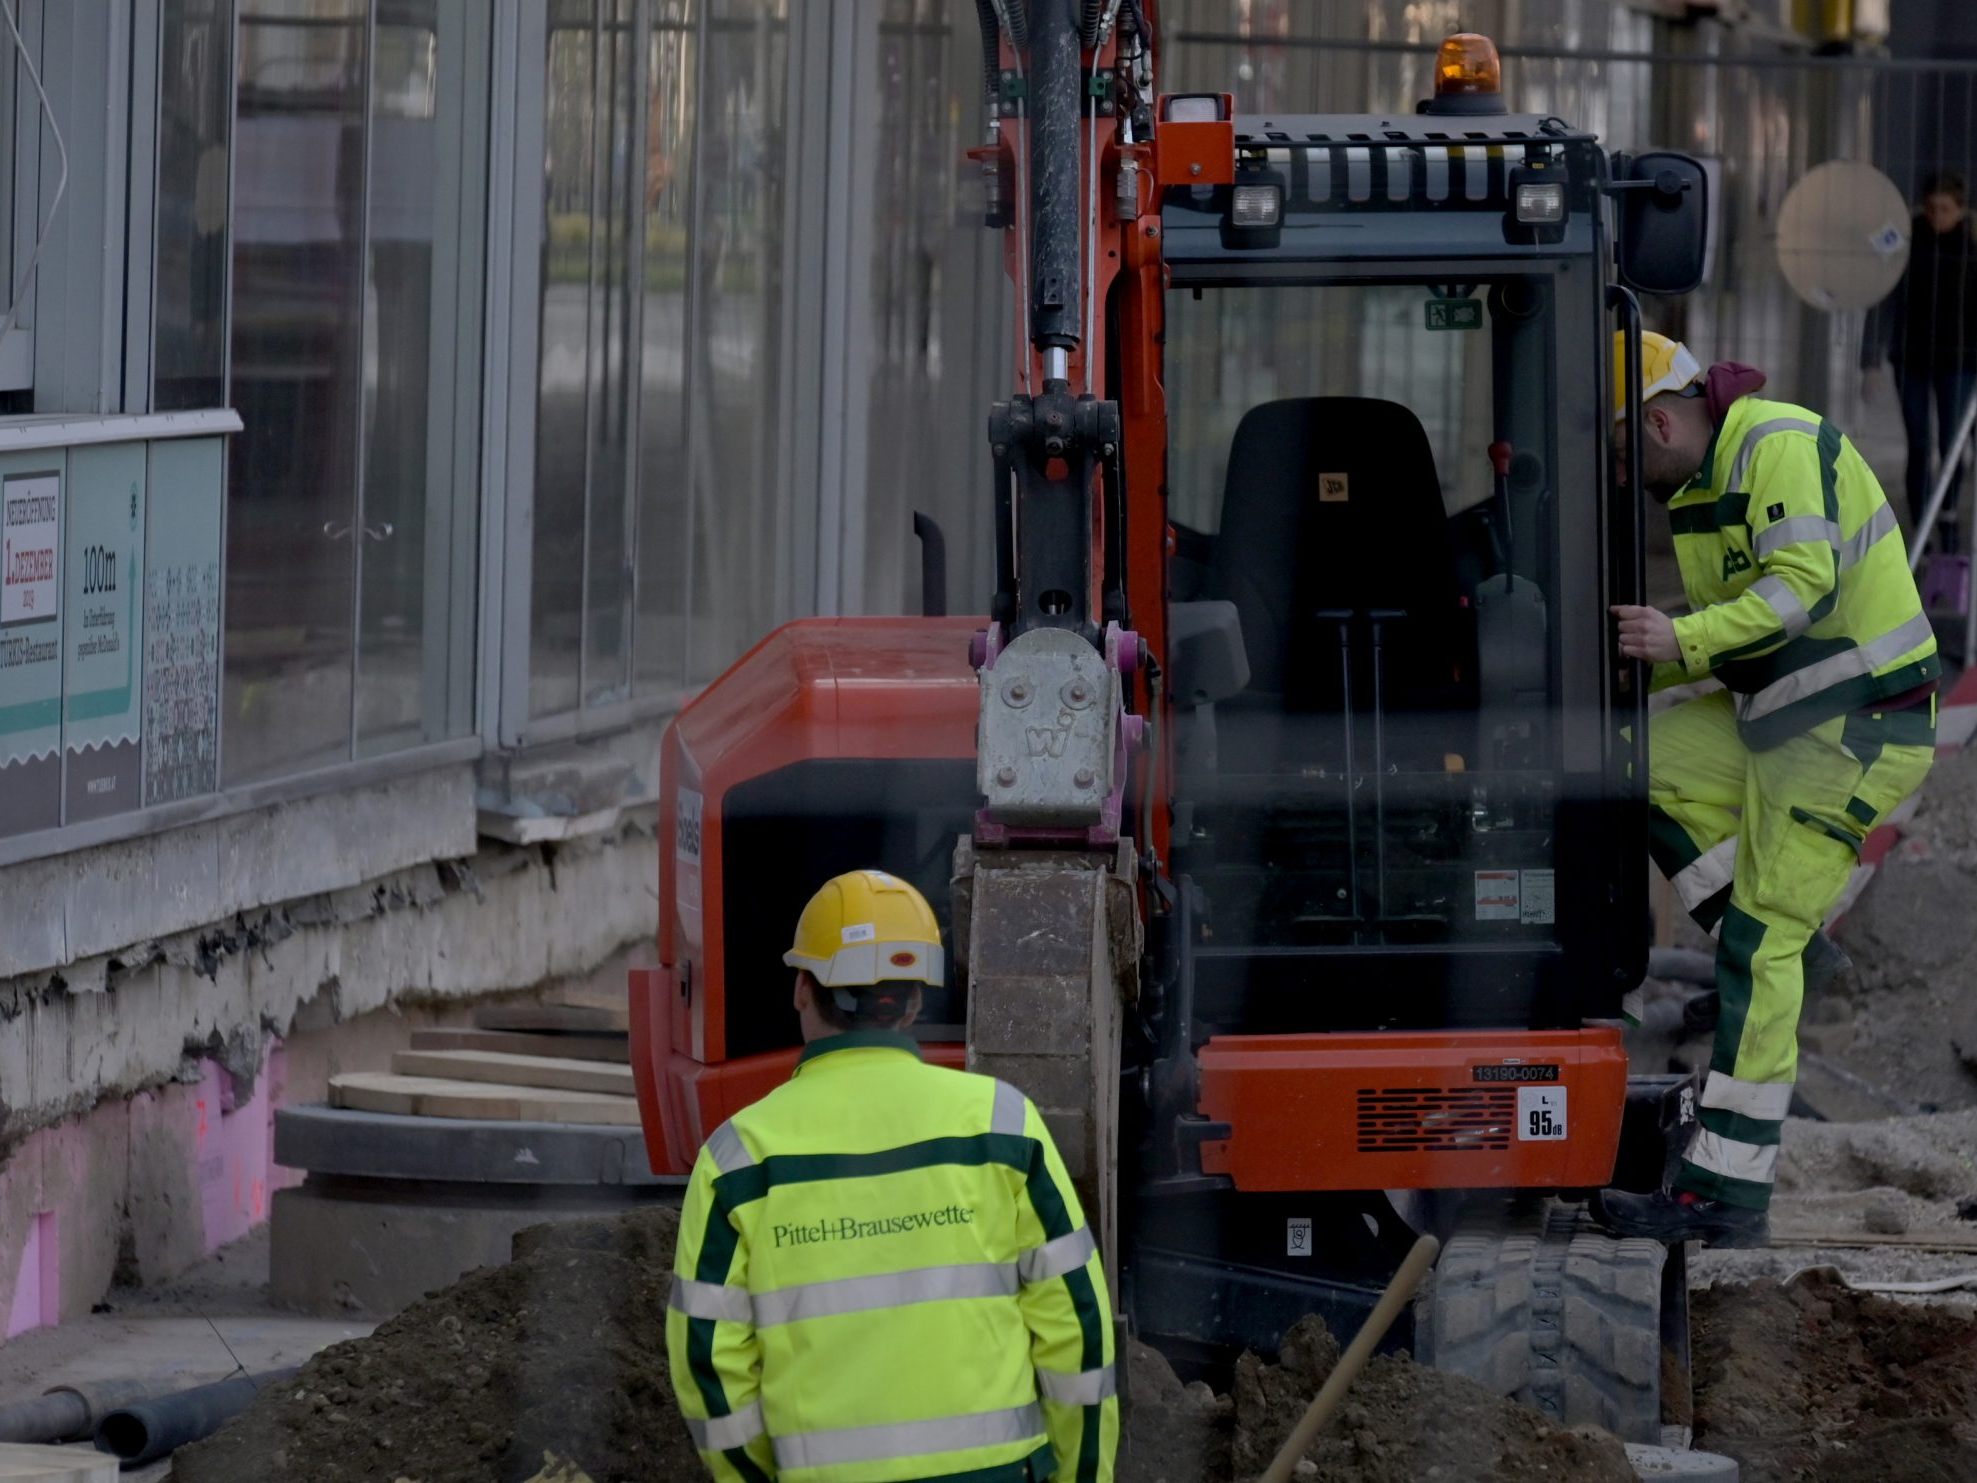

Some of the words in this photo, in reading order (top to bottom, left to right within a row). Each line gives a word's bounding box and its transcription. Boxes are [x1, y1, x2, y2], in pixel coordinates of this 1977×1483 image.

[6, 490, 56, 527] NEUERÖFFNUNG
[83, 545, 117, 593] 100m
[1476, 1067, 1554, 1081] 13190-0074
